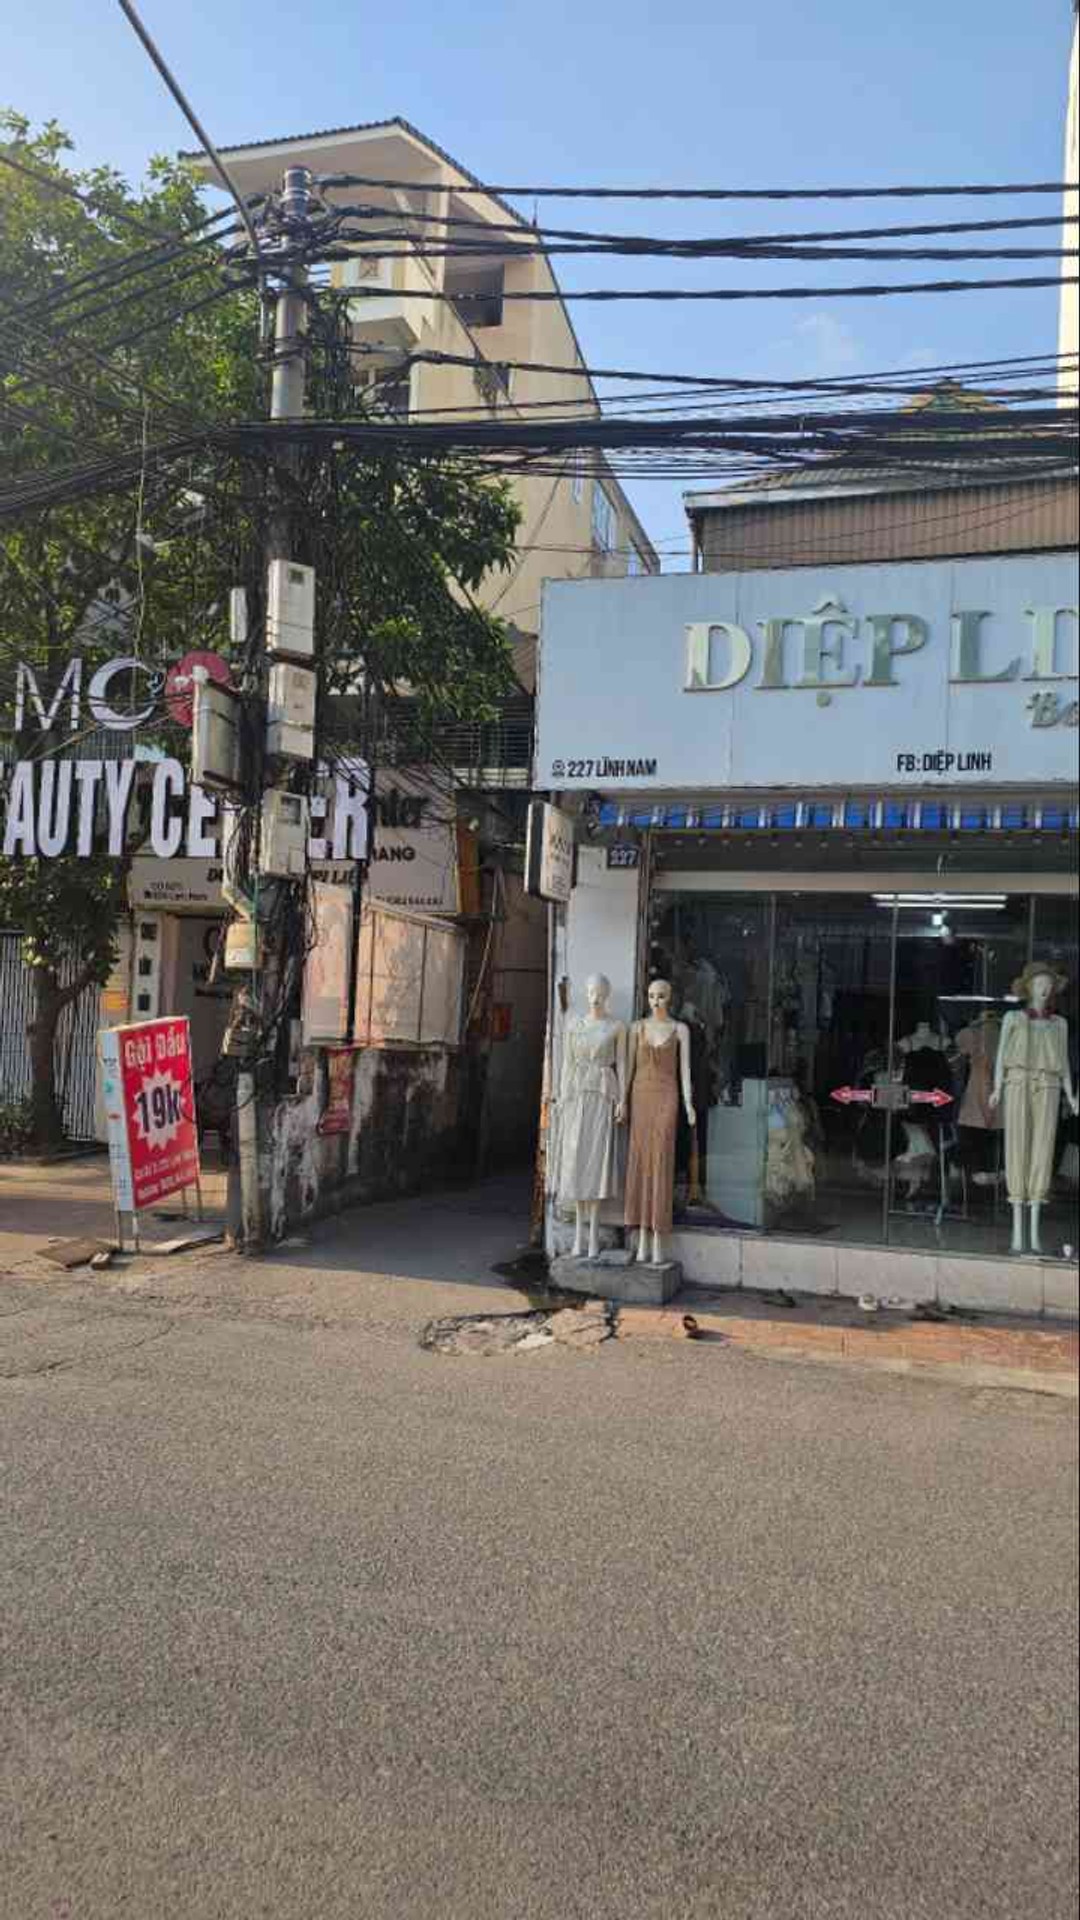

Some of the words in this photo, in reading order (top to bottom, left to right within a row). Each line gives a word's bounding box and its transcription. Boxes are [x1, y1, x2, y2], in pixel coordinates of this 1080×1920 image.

[683, 594, 930, 708] DIỆP
[567, 760, 594, 778] 227
[626, 758, 657, 777] NAM
[923, 749, 955, 776] DIỆP
[957, 751, 993, 772] LINH
[0, 759, 135, 857] AUTY
[610, 849, 637, 866] 227
[124, 1036, 152, 1071] Gội
